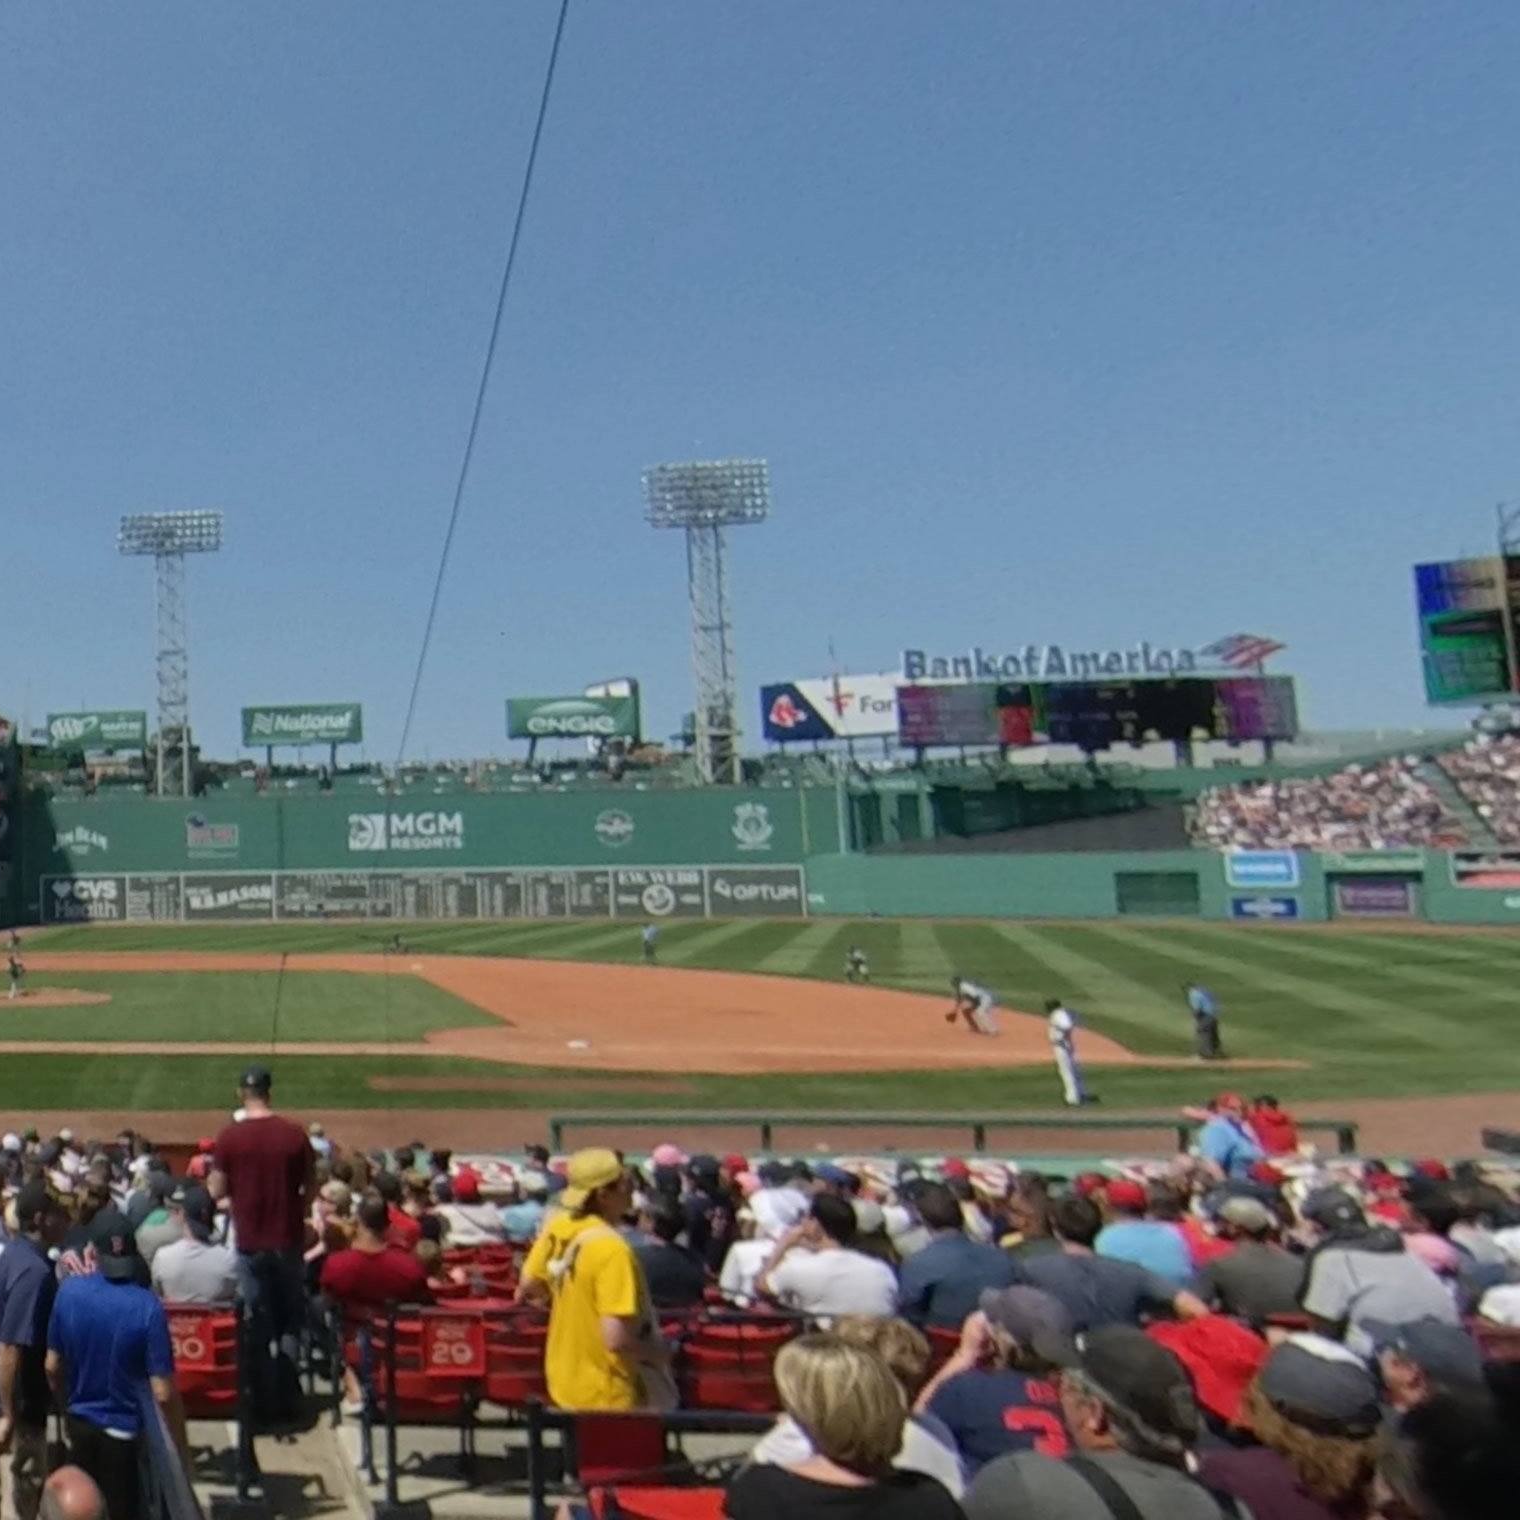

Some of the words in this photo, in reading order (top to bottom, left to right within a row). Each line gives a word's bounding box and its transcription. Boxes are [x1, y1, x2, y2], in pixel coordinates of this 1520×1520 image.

[902, 648, 996, 680] Bank
[997, 645, 1040, 678] of
[1041, 642, 1198, 678] America
[274, 710, 351, 731] National
[390, 812, 463, 835] MGM
[391, 836, 463, 850] RESORTS
[72, 880, 118, 900] CVS
[732, 884, 798, 901] OPTUM
[55, 899, 118, 919] Health
